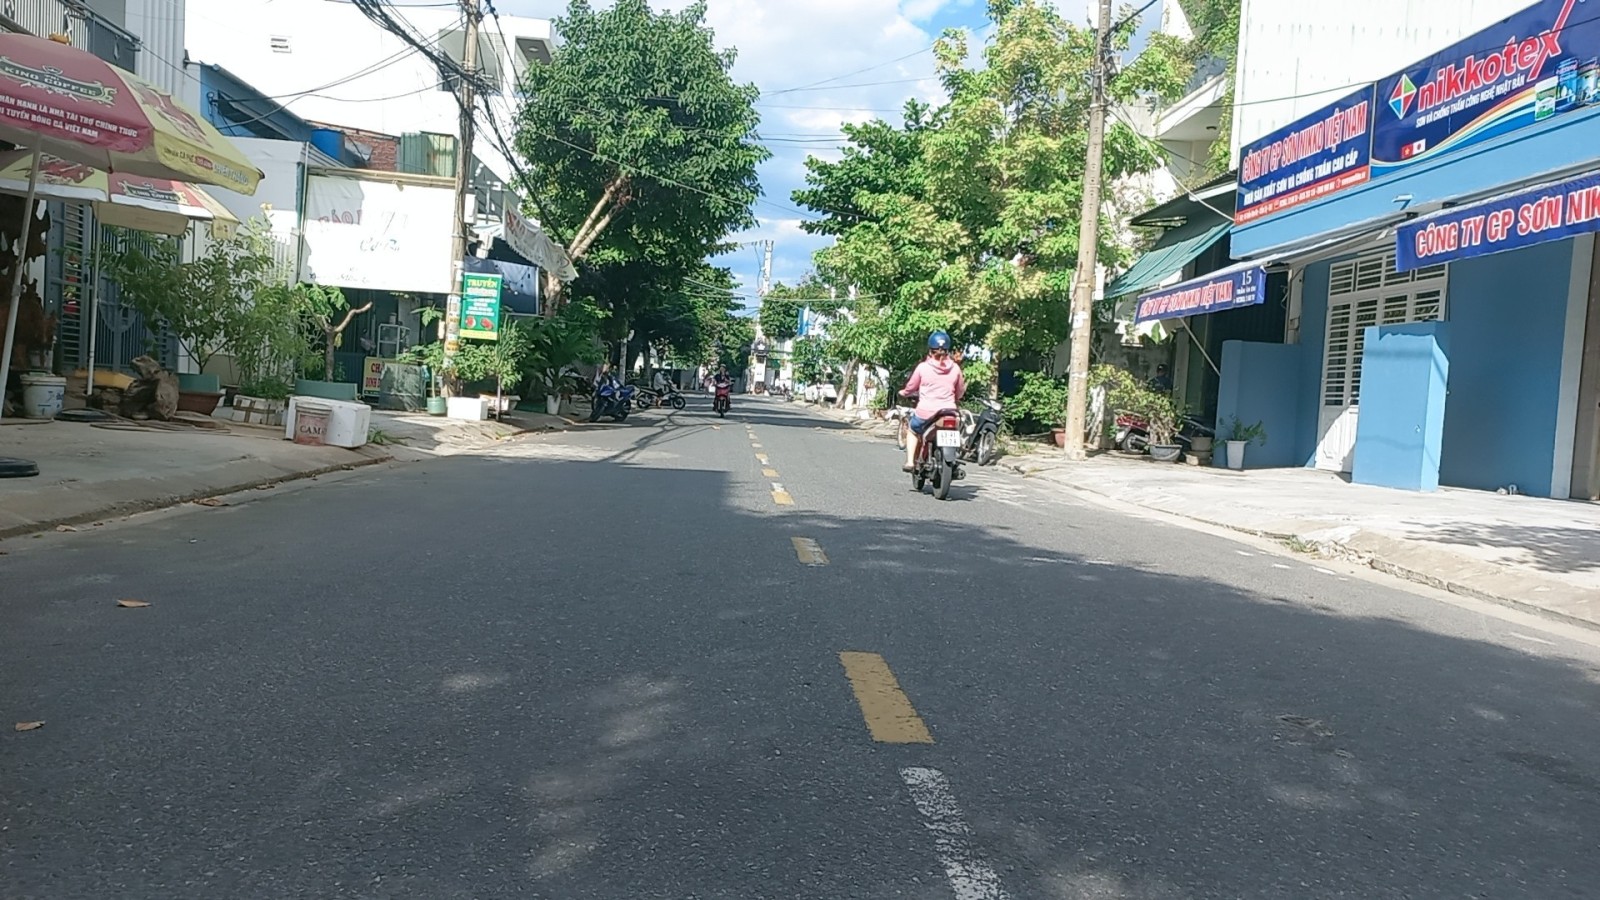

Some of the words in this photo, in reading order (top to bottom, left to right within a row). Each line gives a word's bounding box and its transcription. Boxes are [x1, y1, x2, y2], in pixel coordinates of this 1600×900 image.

[5, 66, 39, 80] KING
[44, 77, 97, 97] COFFEE
[1242, 149, 1262, 184] CÔNG
[1324, 108, 1344, 153] VIỆT
[1343, 100, 1368, 142] NAM
[1415, 222, 1458, 259] CÔNG
[1461, 215, 1486, 248] TY
[1486, 208, 1514, 243] CP
[1517, 193, 1564, 236] SƠN
[1242, 270, 1252, 285] 15
